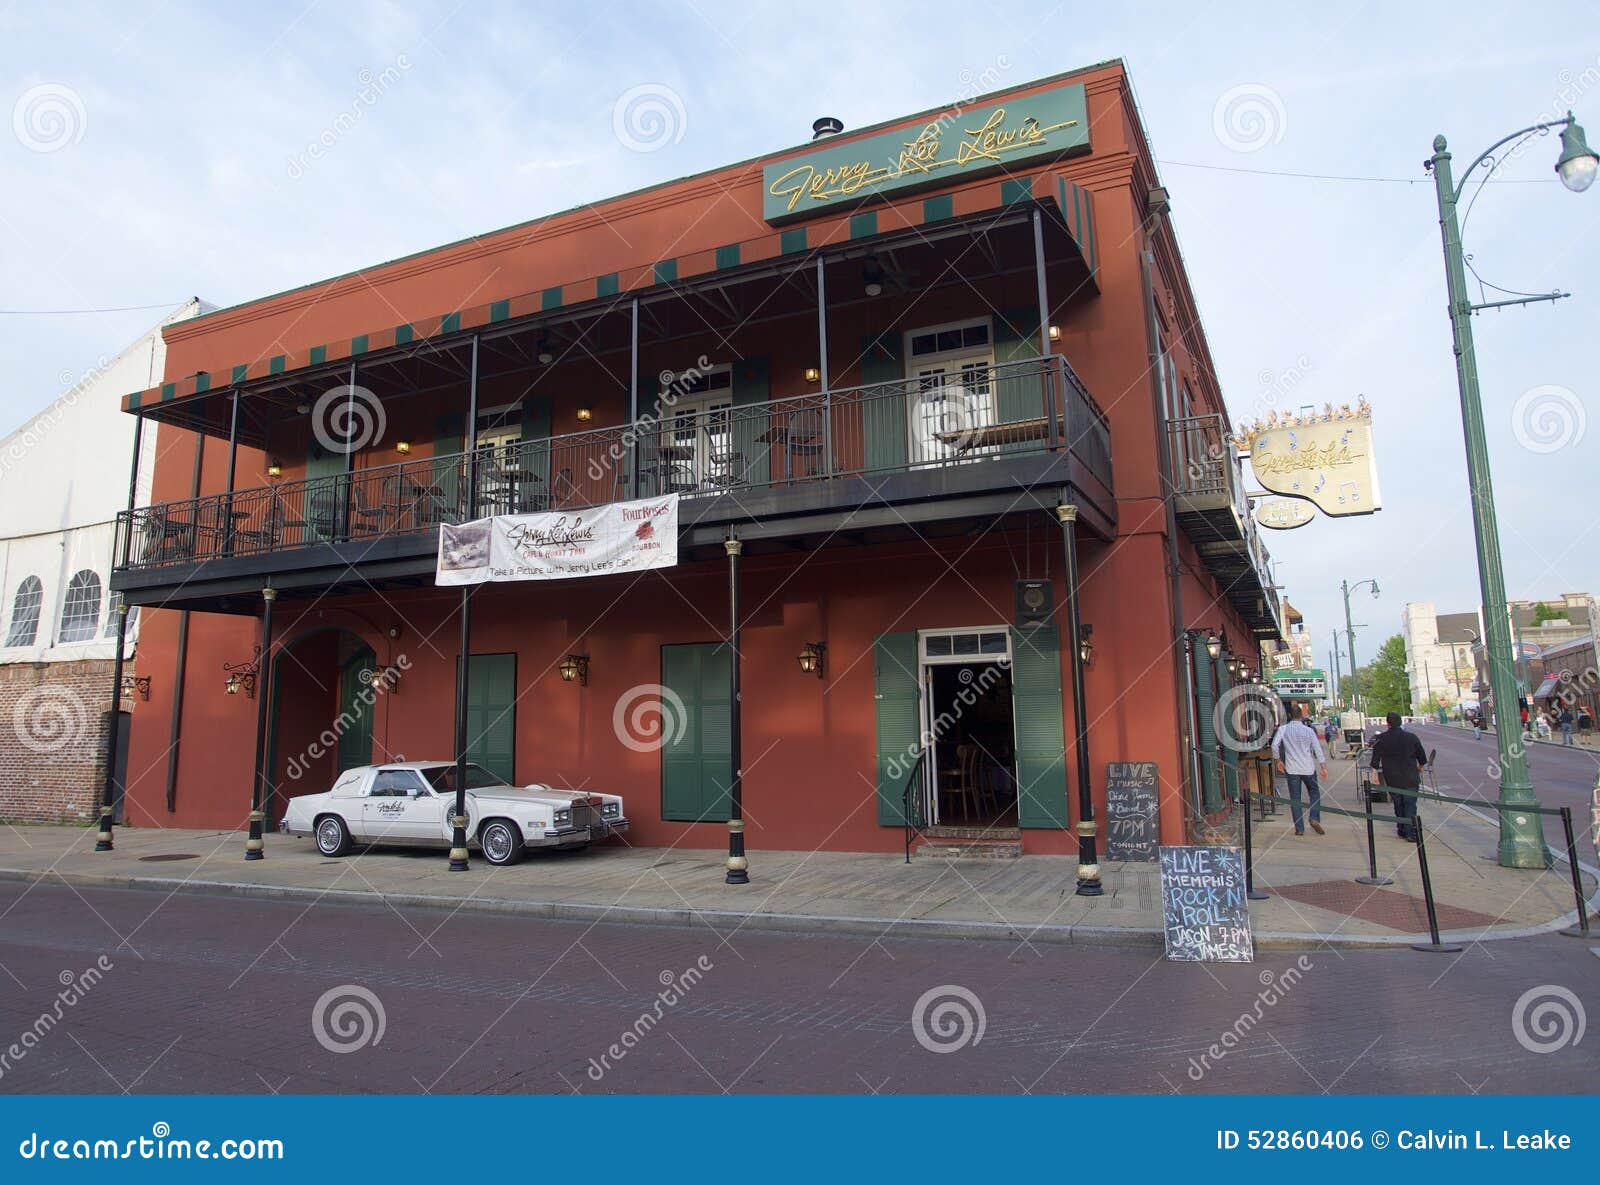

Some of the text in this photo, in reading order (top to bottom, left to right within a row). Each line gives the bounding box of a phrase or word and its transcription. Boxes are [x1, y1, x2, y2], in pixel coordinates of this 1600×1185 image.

[769, 164, 874, 211] Jerry
[898, 122, 942, 174] Lee
[507, 523, 548, 550] Jerry
[548, 516, 567, 546] Lee
[490, 567, 507, 576] Take
[517, 566, 543, 575] Picture
[547, 565, 564, 574] with
[567, 563, 590, 573] Jerry
[1109, 763, 1153, 778] LIVE
[1170, 887, 1220, 910] ROCK
[1182, 905, 1229, 926] ROLL
[1168, 925, 1211, 947] JASON
[1193, 942, 1240, 960] JAMES
